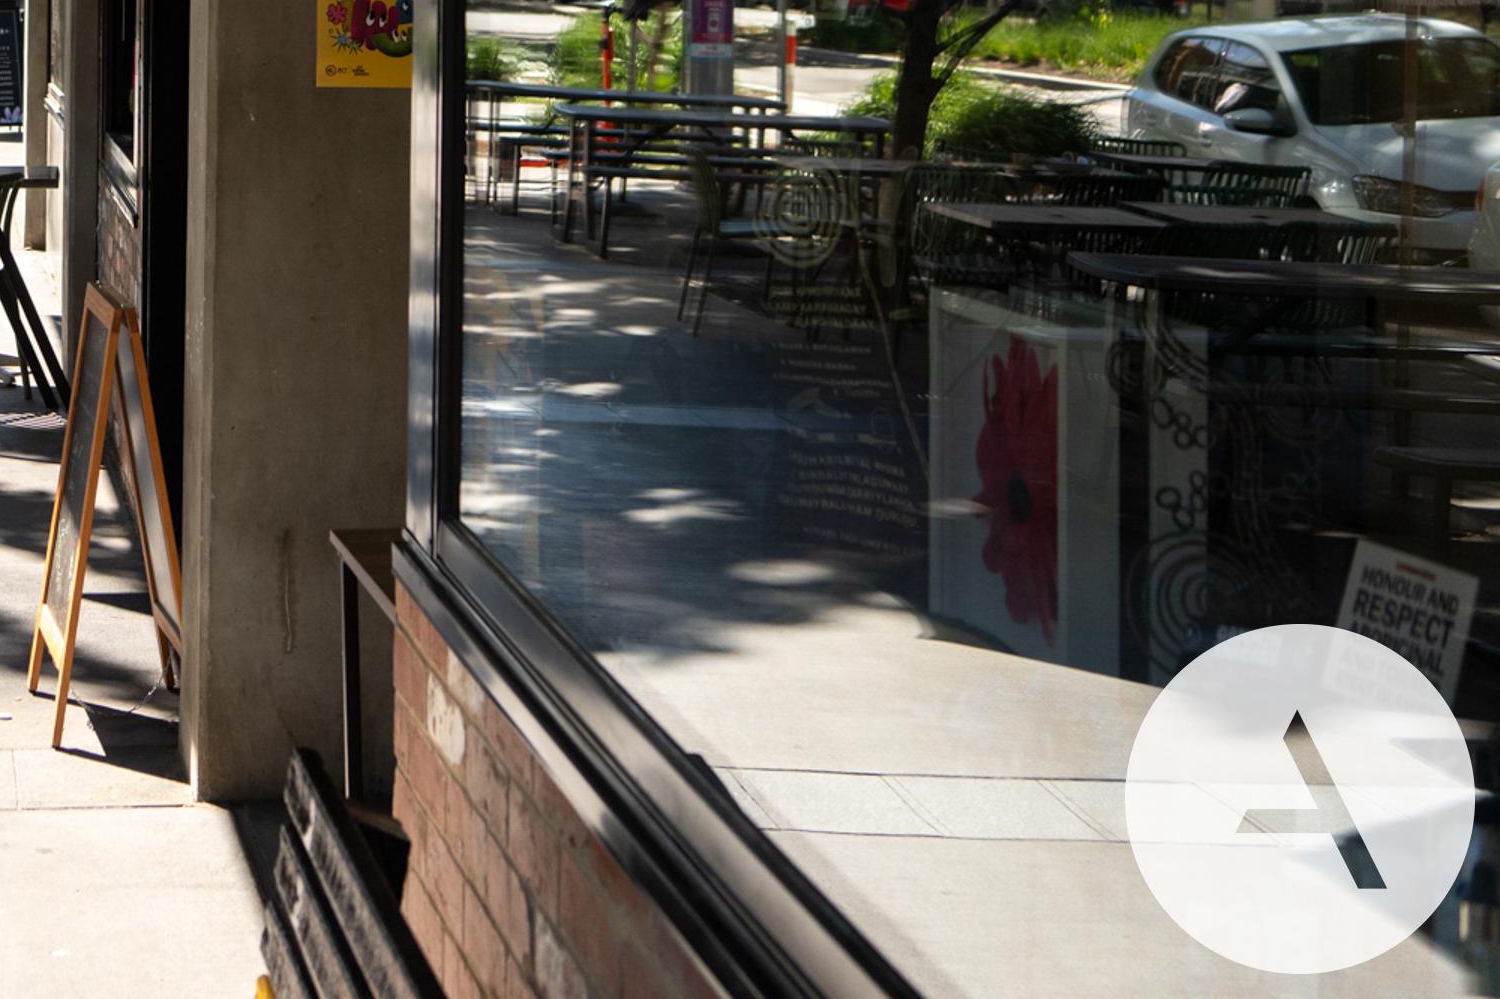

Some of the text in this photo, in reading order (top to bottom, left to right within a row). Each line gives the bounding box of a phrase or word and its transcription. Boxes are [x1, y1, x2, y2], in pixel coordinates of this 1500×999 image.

[1353, 588, 1456, 649] RESPECT
[1361, 566, 1459, 616] HONOUR AND
